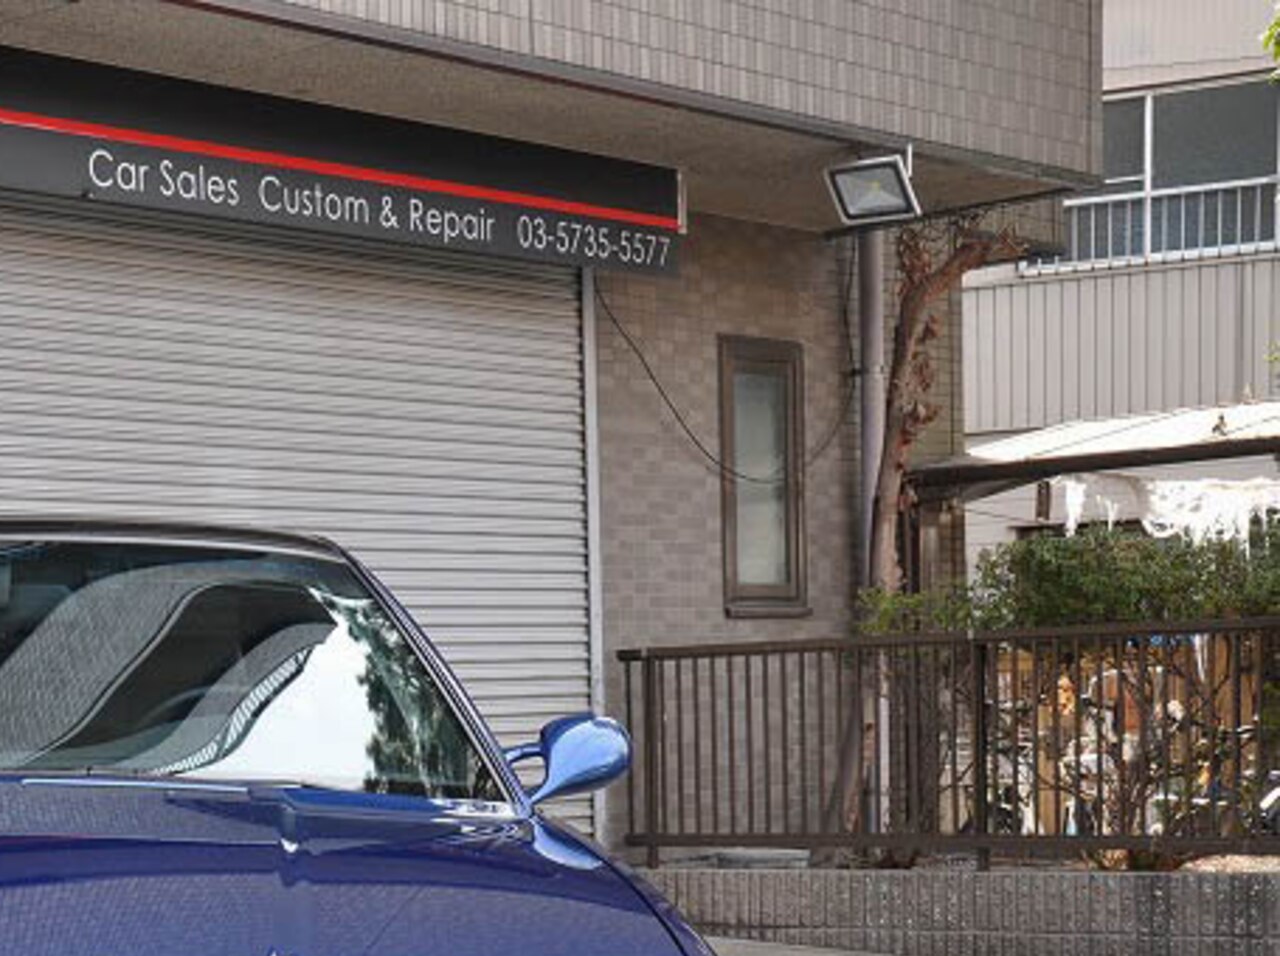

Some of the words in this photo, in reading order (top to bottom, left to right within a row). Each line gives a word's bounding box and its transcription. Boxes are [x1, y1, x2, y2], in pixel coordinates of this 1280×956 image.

[89, 150, 148, 197] Car
[160, 160, 239, 205] Sales
[260, 176, 368, 222] Custom
[380, 196, 398, 227] &
[410, 199, 494, 242] Repair
[519, 216, 669, 263] 03-5735-5577
